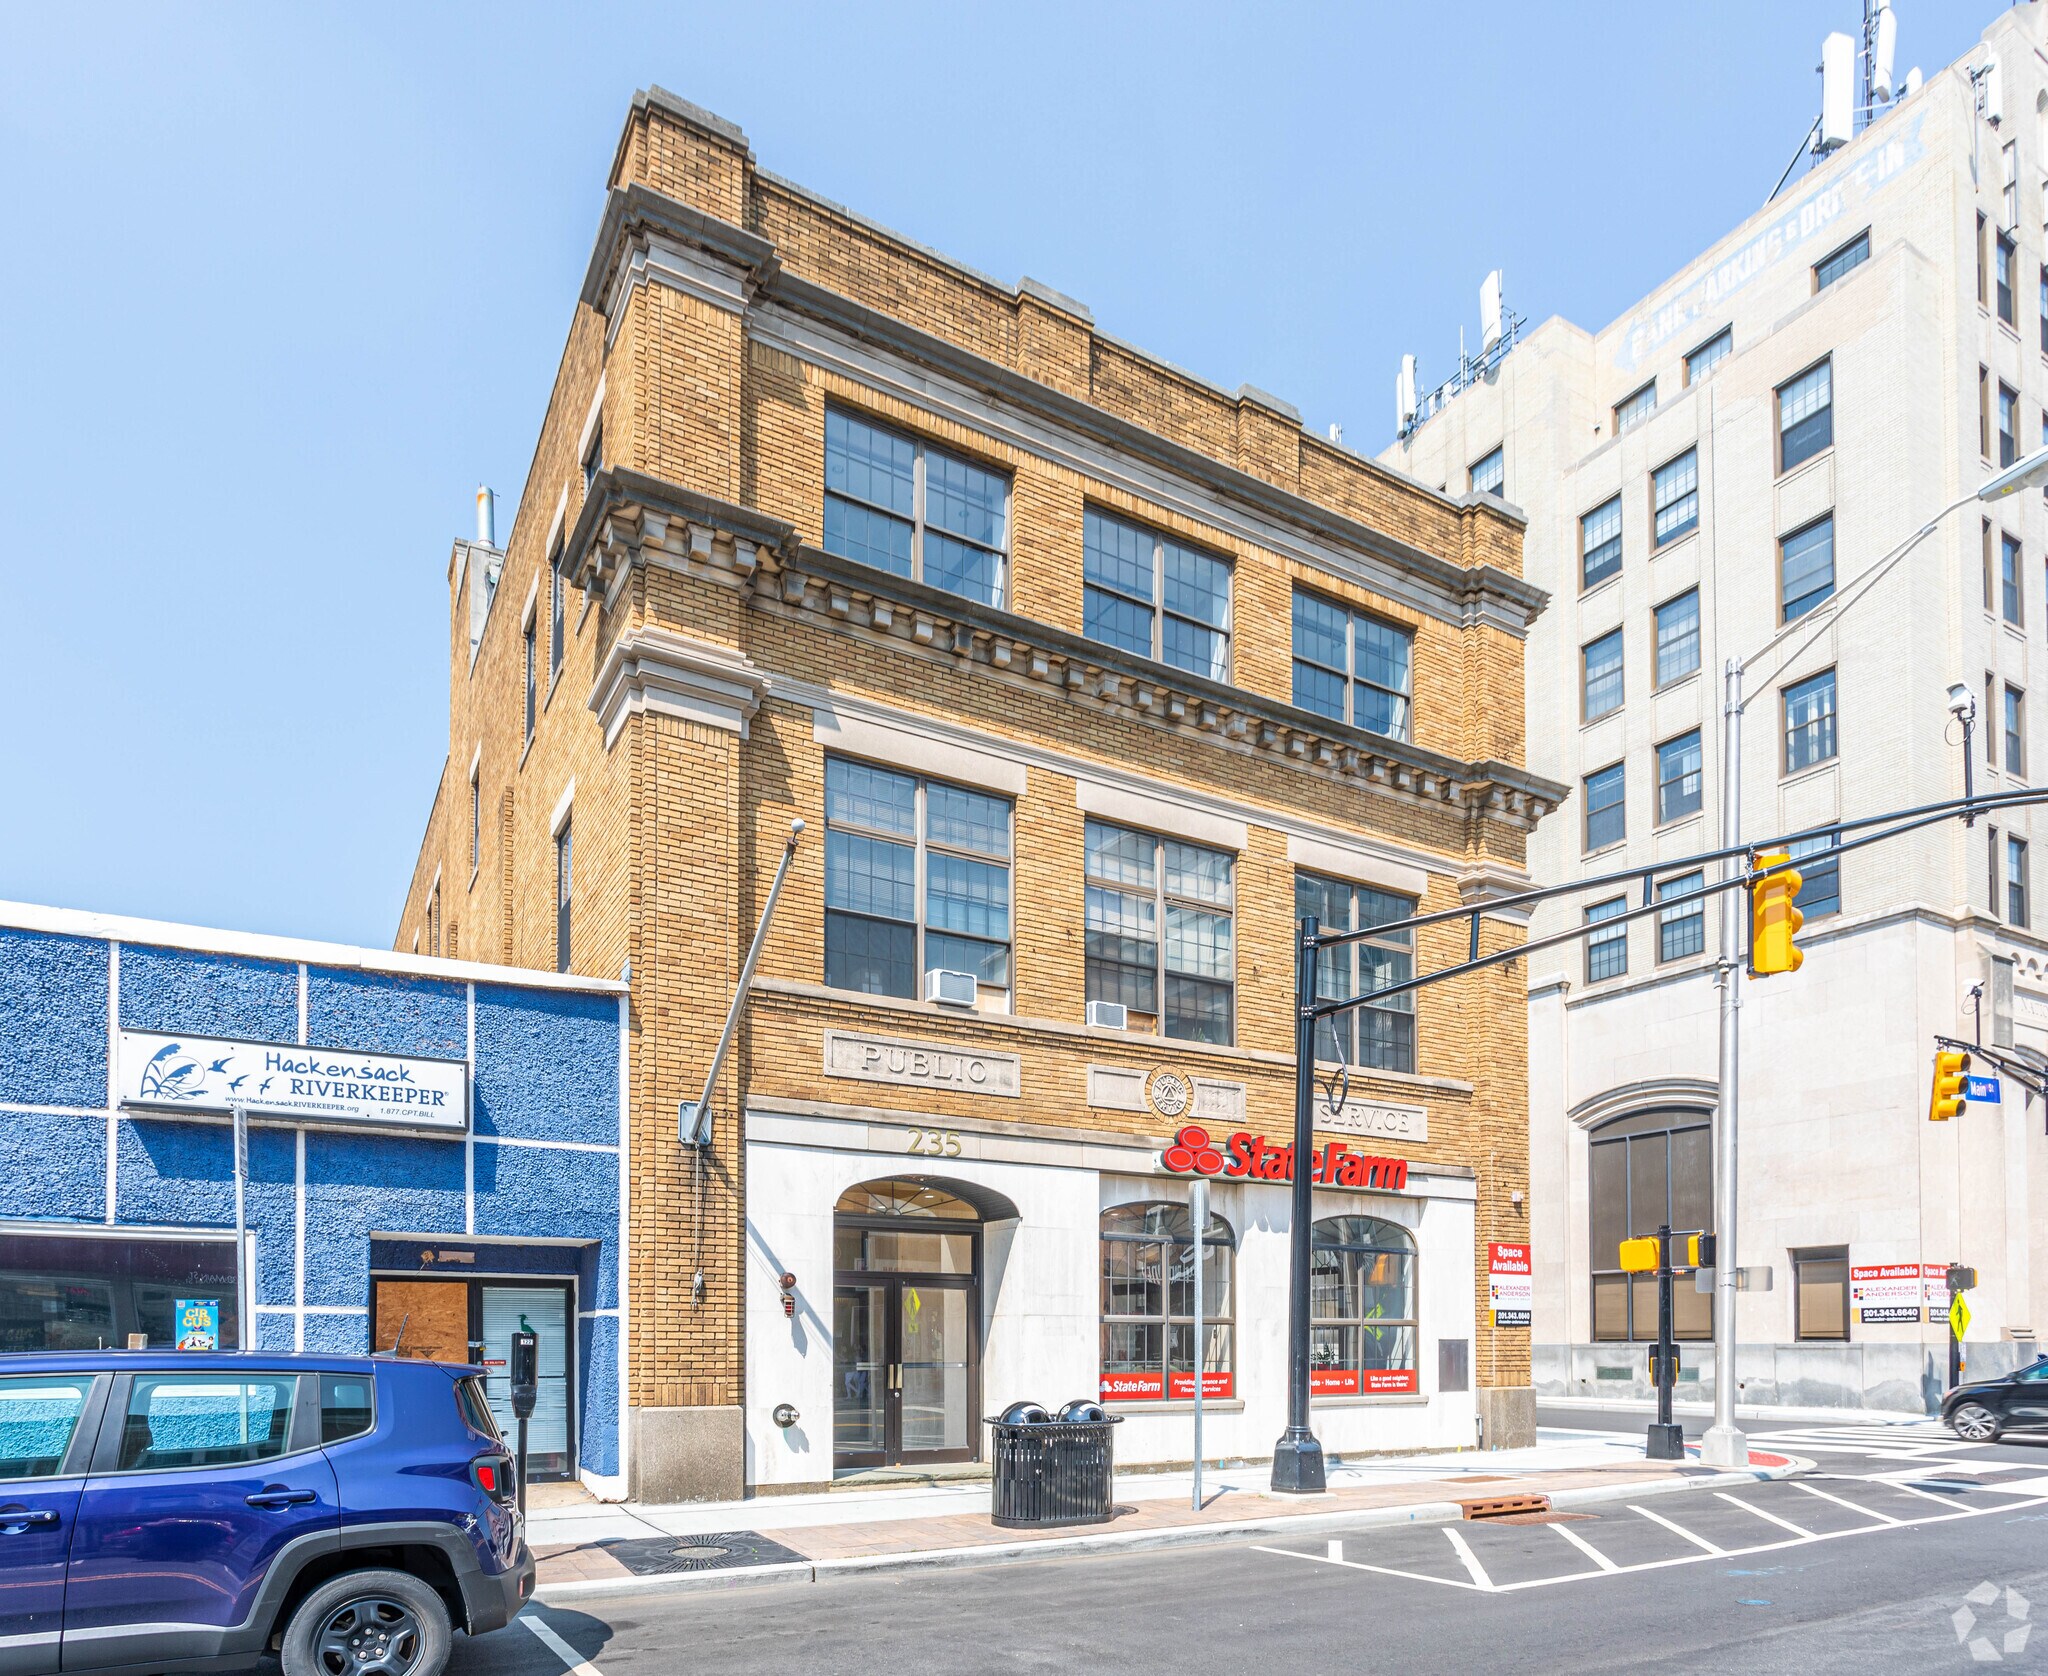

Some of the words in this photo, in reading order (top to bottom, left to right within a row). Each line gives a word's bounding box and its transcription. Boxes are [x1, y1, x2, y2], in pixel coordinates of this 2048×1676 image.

[1693, 227, 1784, 314] ARKING
[1800, 140, 1905, 240] DRIE-IN
[265, 1052, 416, 1083] Hackensack
[861, 1045, 987, 1083] PUBLIC
[1155, 1076, 1184, 1095] PUBLIC
[1970, 1081, 1987, 1097] Main
[1988, 1083, 1995, 1093] St
[380, 1107, 435, 1118] 1.877.CPT.BILL
[1319, 1104, 1409, 1133] SERVICE
[906, 1127, 962, 1157] 235
[1497, 1245, 1523, 1260] Space
[1492, 1259, 1529, 1272] Available
[1924, 1266, 1939, 1277] Space
[1853, 1268, 1878, 1279] Space
[1880, 1267, 1918, 1278] Available
[185, 1307, 208, 1317] CIR
[1862, 1308, 1919, 1317] 201.343.6640
[182, 1316, 212, 1327] CUS
[1325, 1378, 1341, 1386] Home
[1344, 1378, 1354, 1386] Life
